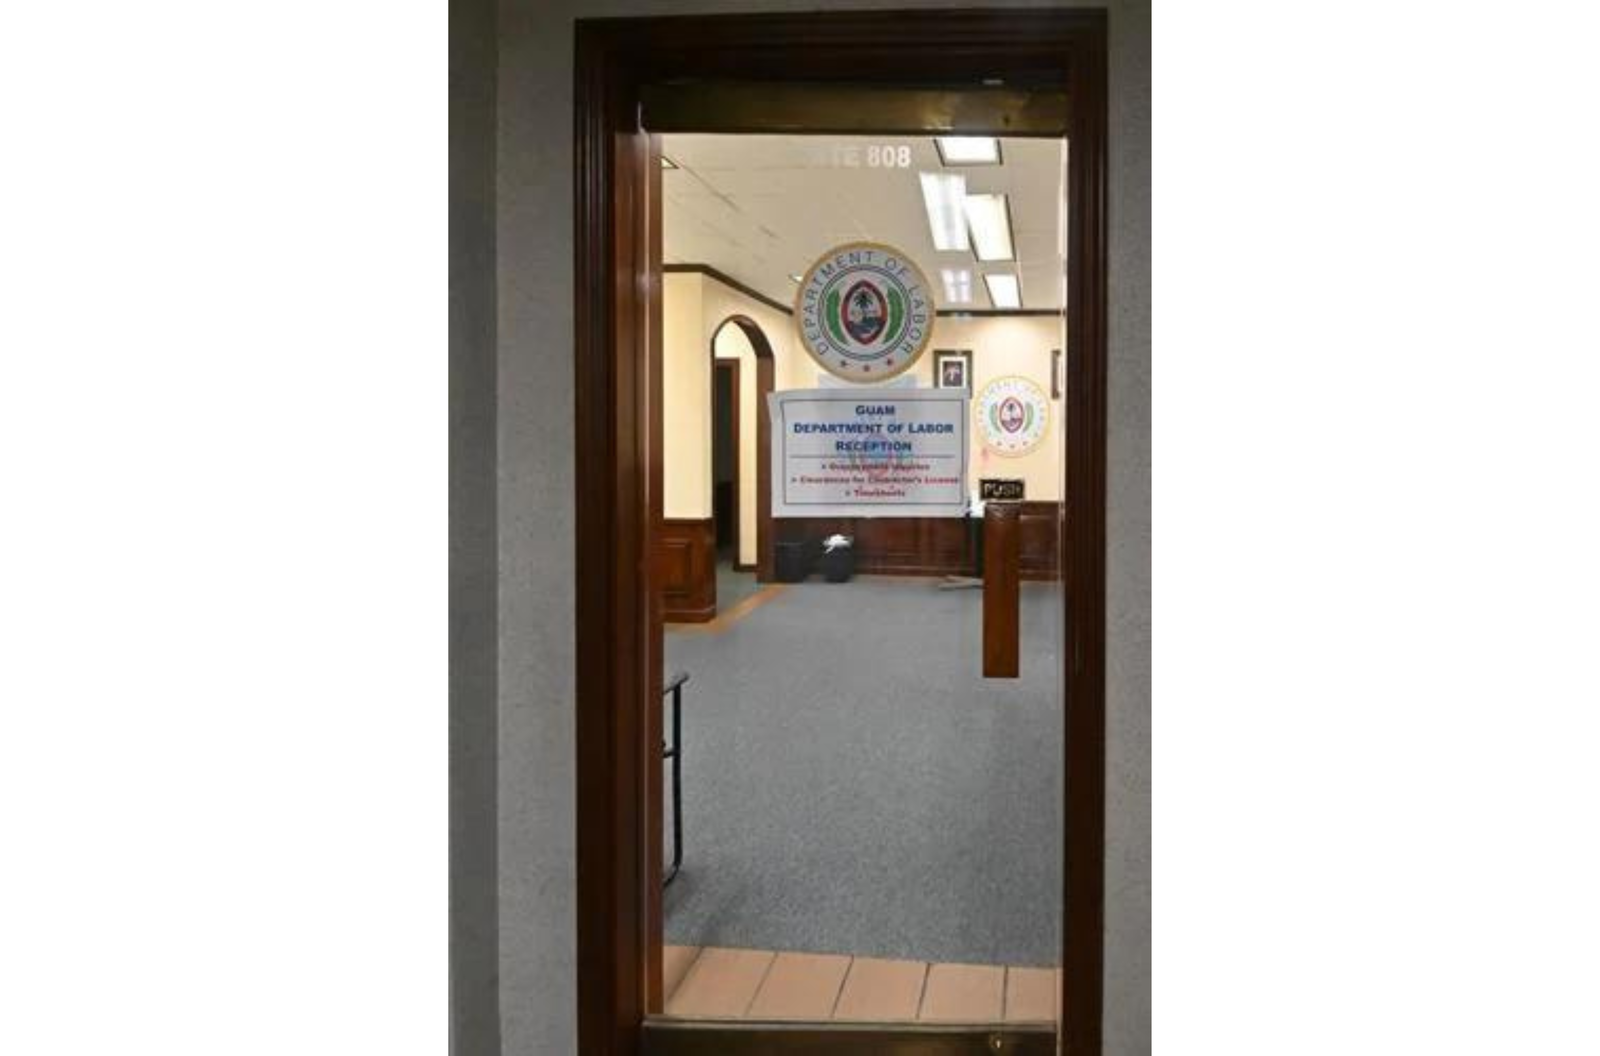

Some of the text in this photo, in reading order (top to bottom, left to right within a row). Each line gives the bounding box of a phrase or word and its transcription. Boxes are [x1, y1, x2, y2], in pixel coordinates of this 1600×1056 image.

[867, 145, 912, 168] 808
[803, 251, 926, 356] DEPARTMENT OF LABOR
[855, 404, 896, 416] GUAM
[793, 422, 954, 434] DEPARTMENT OF LABOR
[835, 440, 912, 452] RECEPTION
